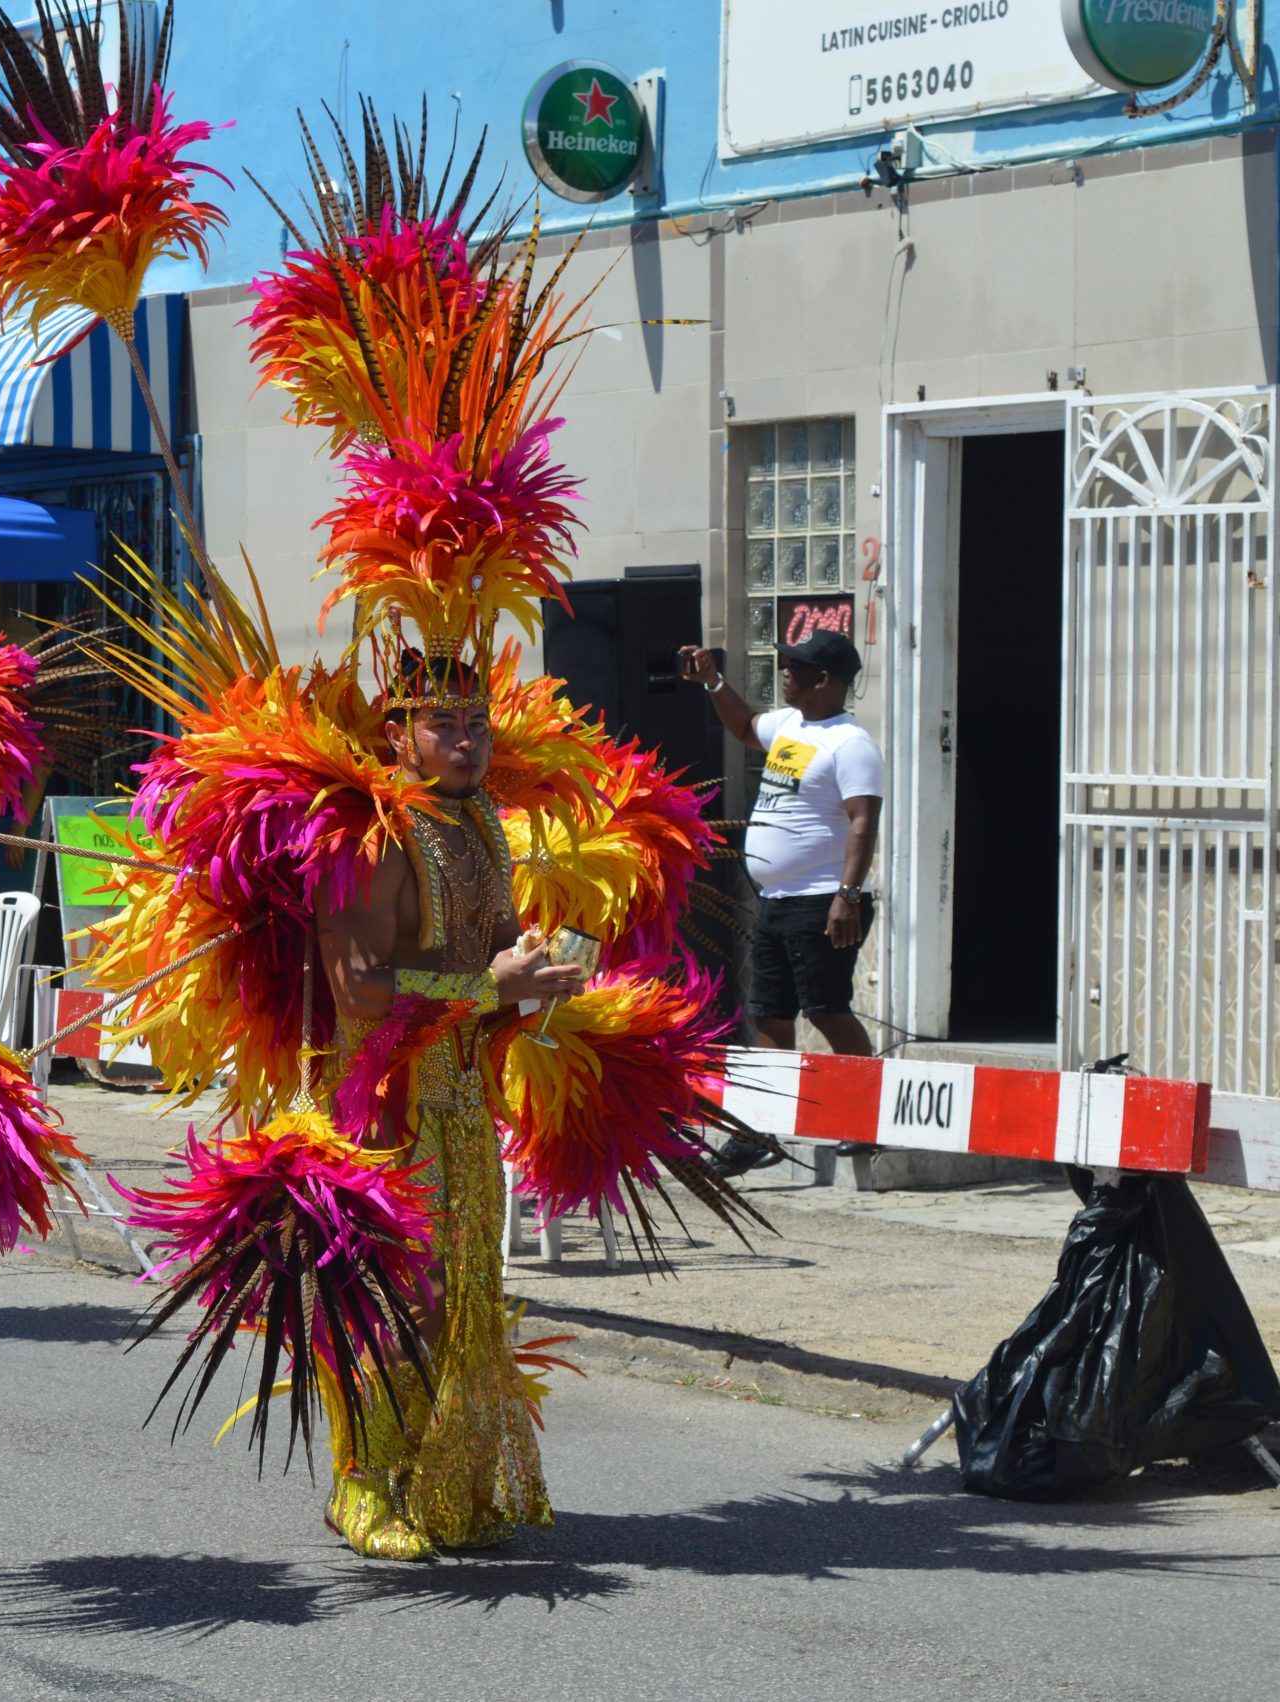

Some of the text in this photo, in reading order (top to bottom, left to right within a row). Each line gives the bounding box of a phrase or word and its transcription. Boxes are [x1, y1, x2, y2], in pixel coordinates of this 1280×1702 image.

[821, 27, 864, 52] LATIN
[867, 14, 927, 43] CUISINE
[942, 0, 1009, 29] CRIOLLO
[866, 60, 974, 106] 5663040
[547, 130, 638, 155] Heineken
[762, 761, 799, 787] ACOSTE
